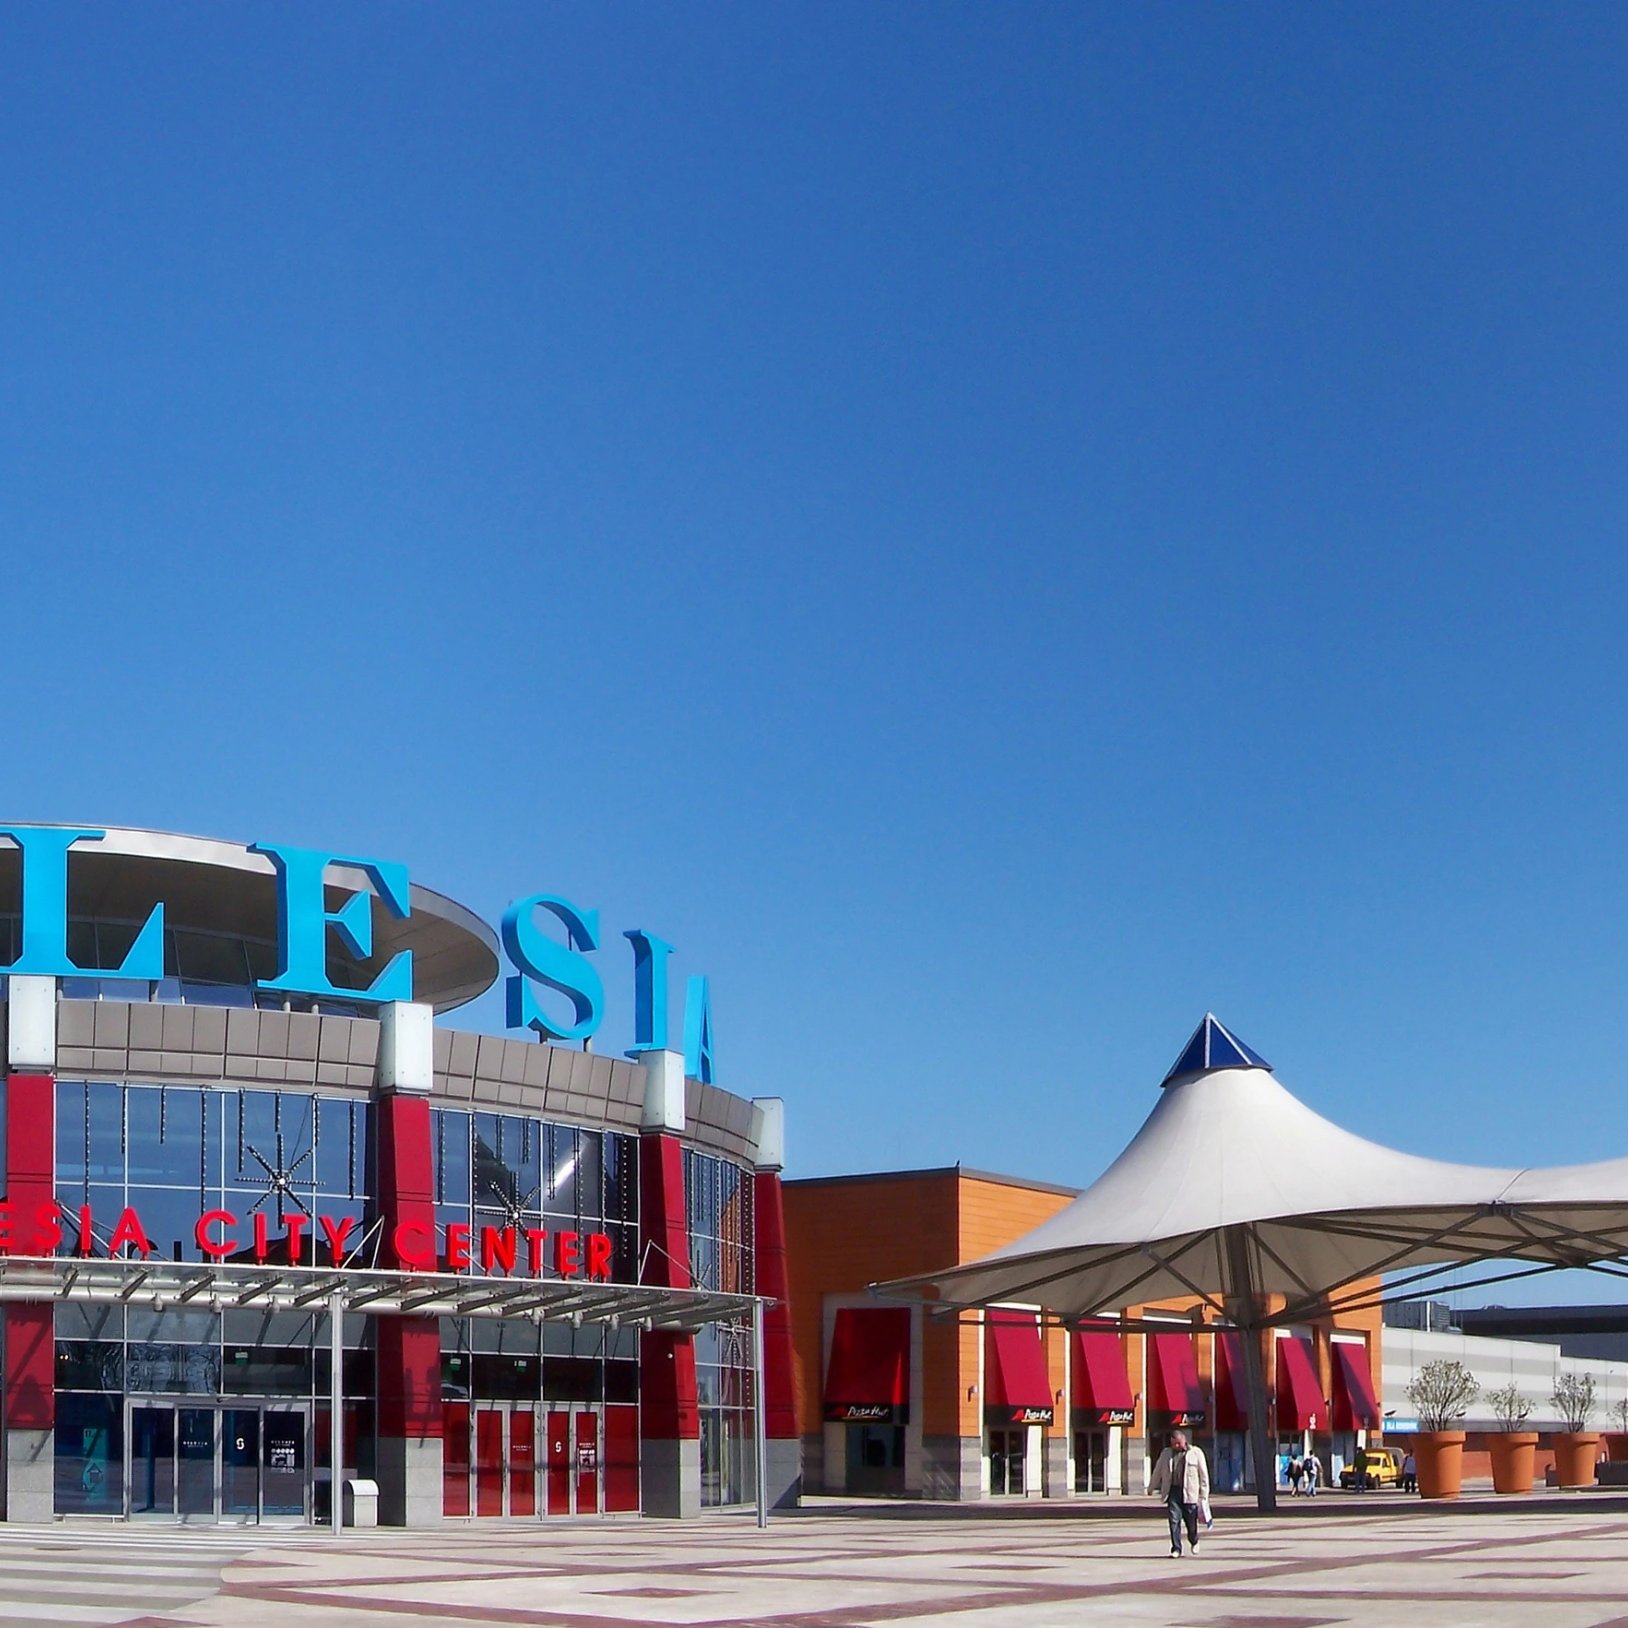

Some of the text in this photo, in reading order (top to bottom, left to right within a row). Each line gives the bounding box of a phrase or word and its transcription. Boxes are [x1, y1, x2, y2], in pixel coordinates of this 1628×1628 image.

[0, 828, 716, 1084] LESIA
[195, 1209, 353, 1262] CITY
[394, 1221, 612, 1277] CENTER
